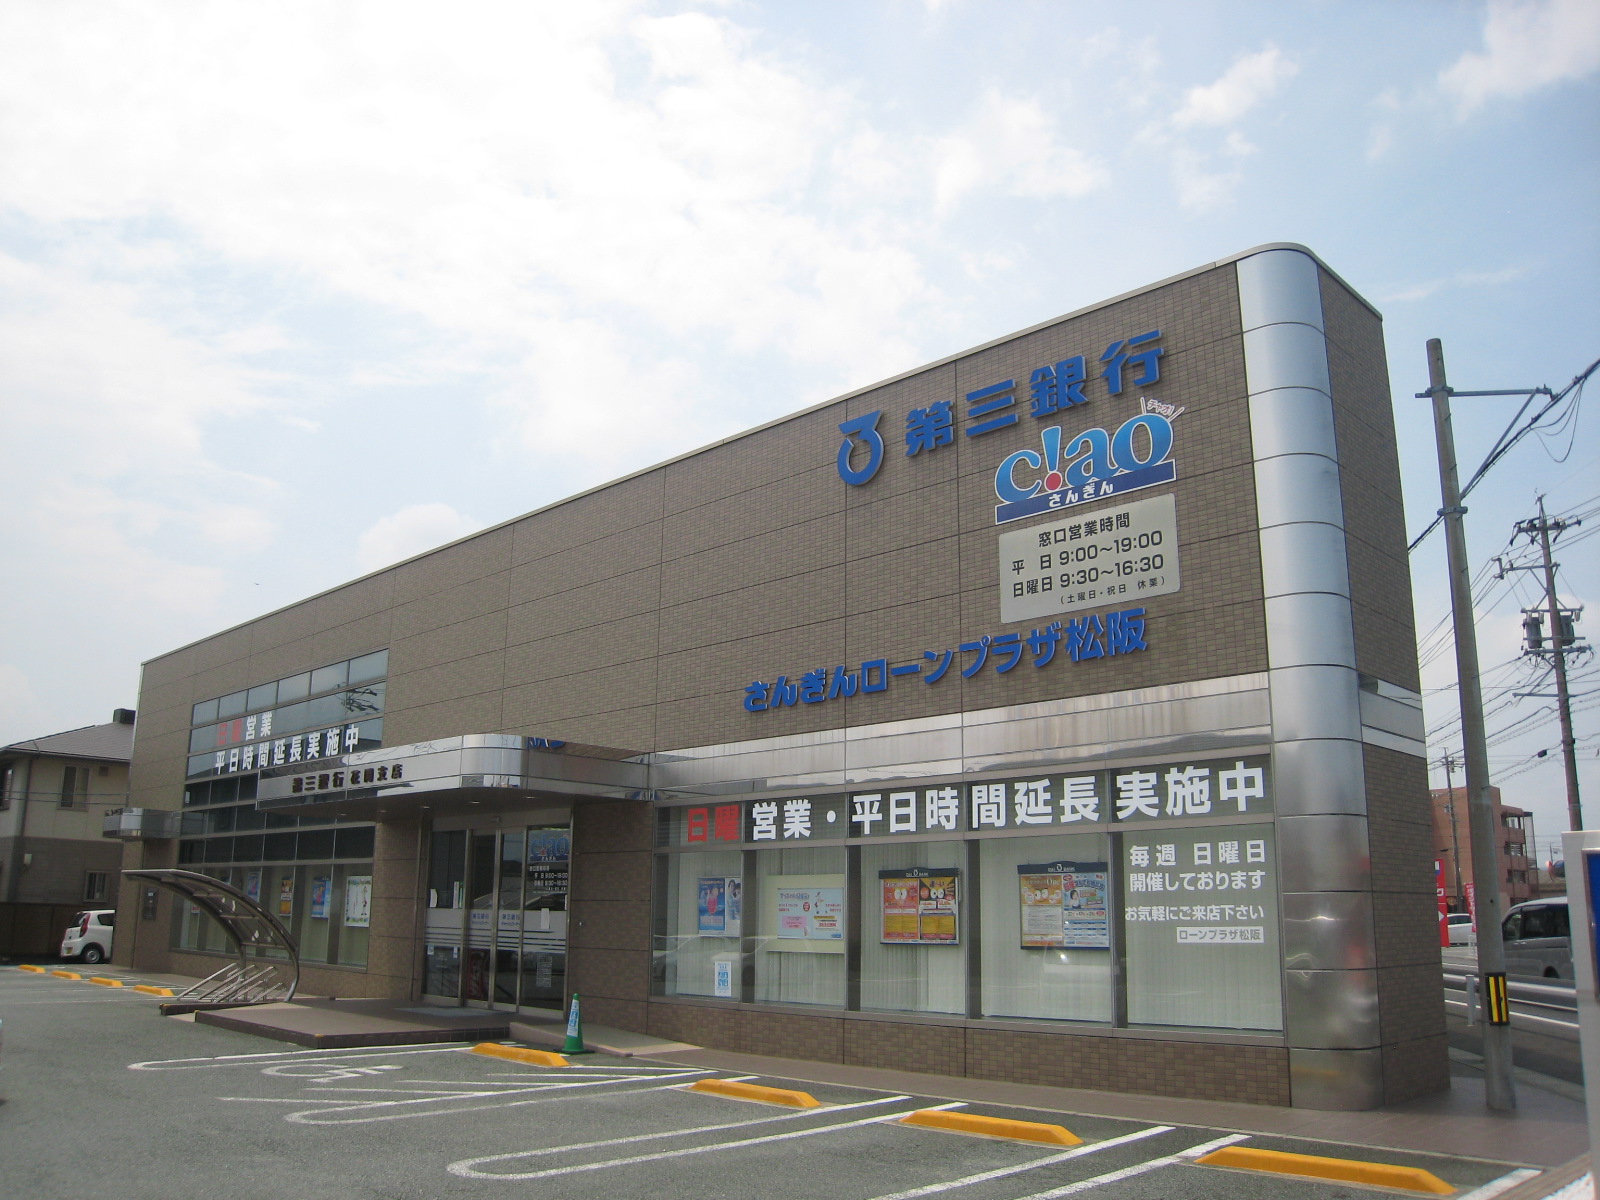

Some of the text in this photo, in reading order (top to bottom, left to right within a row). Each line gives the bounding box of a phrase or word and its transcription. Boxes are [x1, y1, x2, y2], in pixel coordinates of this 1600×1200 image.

[905, 329, 1166, 457] 第三銀行
[1047, 480, 1115, 508] さんぎん
[1038, 512, 1130, 548] 窓口営業時間
[1013, 575, 1053, 598] 日曜日
[745, 607, 1148, 711] さんぎんローンプラザ松阪
[214, 724, 360, 775] 平日時間延長実施中
[1129, 839, 1266, 868] 毎週 日曜日
[1129, 869, 1266, 892] 開催しております
[1124, 904, 1265, 922] お気軽にご来店下さい
[1179, 929, 1261, 941] ローンプラザ松阪
